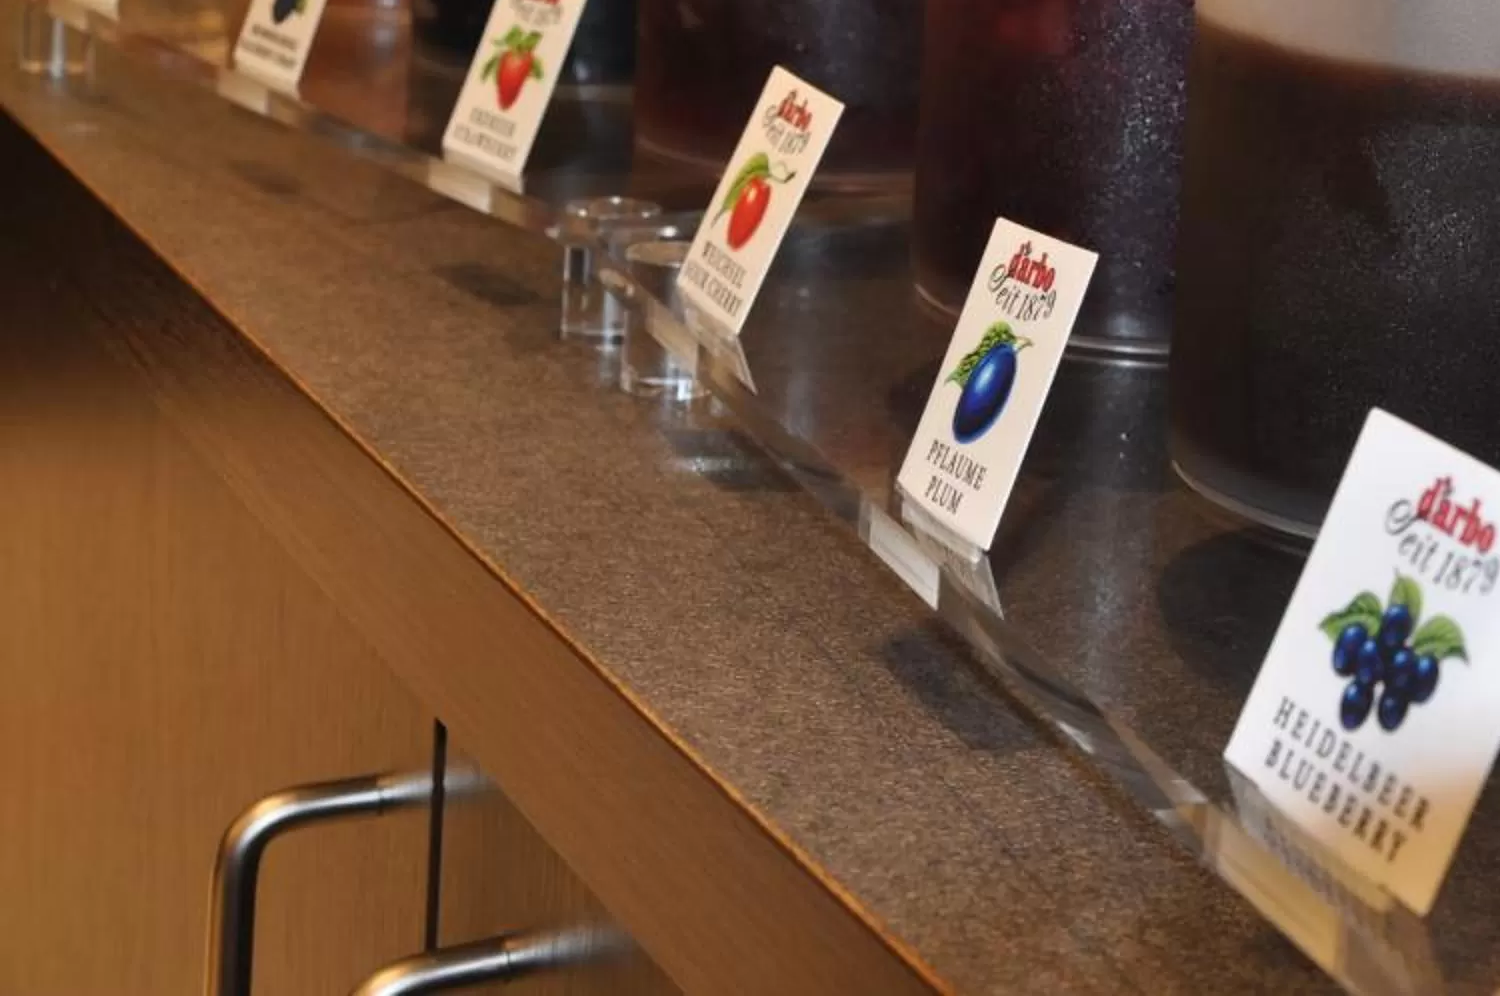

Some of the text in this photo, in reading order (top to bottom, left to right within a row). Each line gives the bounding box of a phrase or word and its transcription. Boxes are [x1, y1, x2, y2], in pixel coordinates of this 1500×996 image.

[1015, 290, 1057, 321] 1879
[926, 439, 988, 492] PFLAUME
[924, 476, 964, 516] PLUM
[1432, 552, 1500, 596] 1879
[1273, 696, 1430, 832] HEIDELBEER
[1264, 739, 1408, 865] BLUEBERRY
